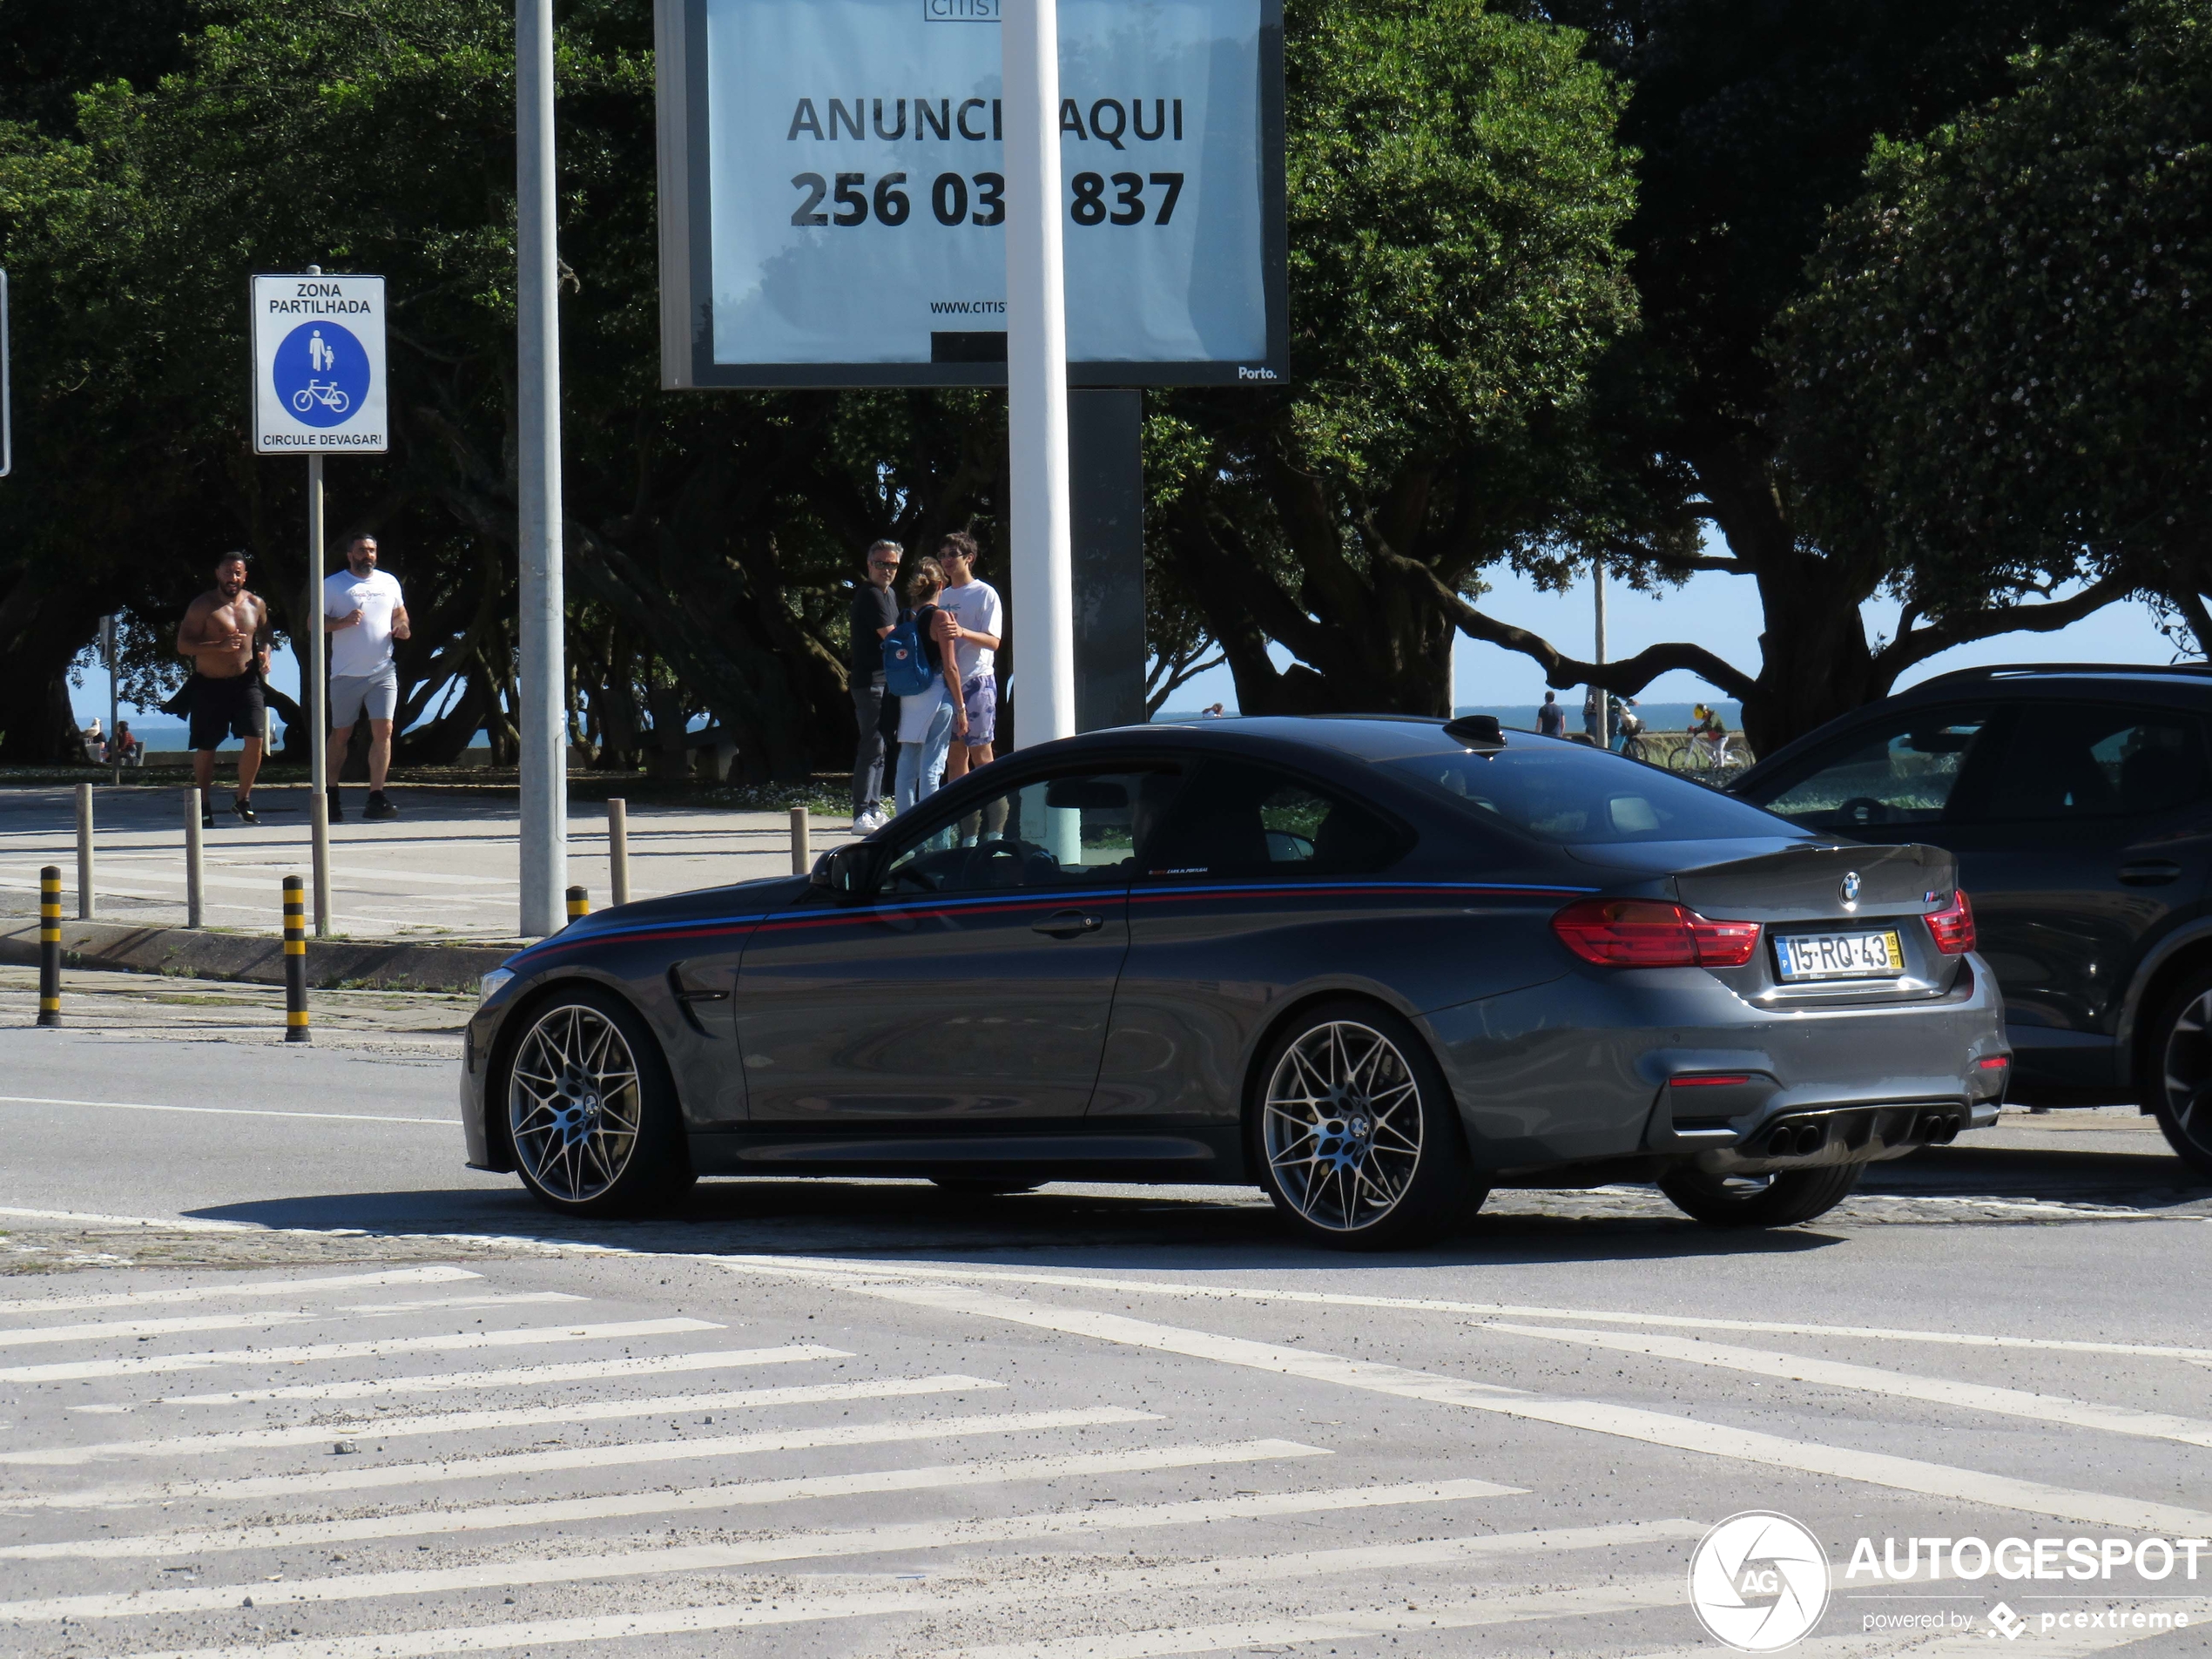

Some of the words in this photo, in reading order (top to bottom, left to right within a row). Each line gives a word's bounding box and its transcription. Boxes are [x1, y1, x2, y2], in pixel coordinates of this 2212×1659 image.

[786, 98, 1002, 141] ANUNCI
[1059, 98, 1184, 151] AQUI
[790, 172, 910, 226] 256
[932, 172, 1005, 226] 03
[1070, 172, 1184, 226] 837
[297, 283, 341, 297] ZONA
[269, 300, 371, 314] PARTILHADA
[930, 301, 1008, 314] WWW.CITIS
[1238, 366, 1278, 380] Porto.
[263, 435, 316, 446] CIRCULE
[320, 435, 382, 445] DEVAGAR!
[1886, 935, 1896, 947] 16
[1789, 934, 1888, 971] 15-RQ-43
[1782, 959, 1788, 968] P
[1890, 954, 1899, 966] 07
